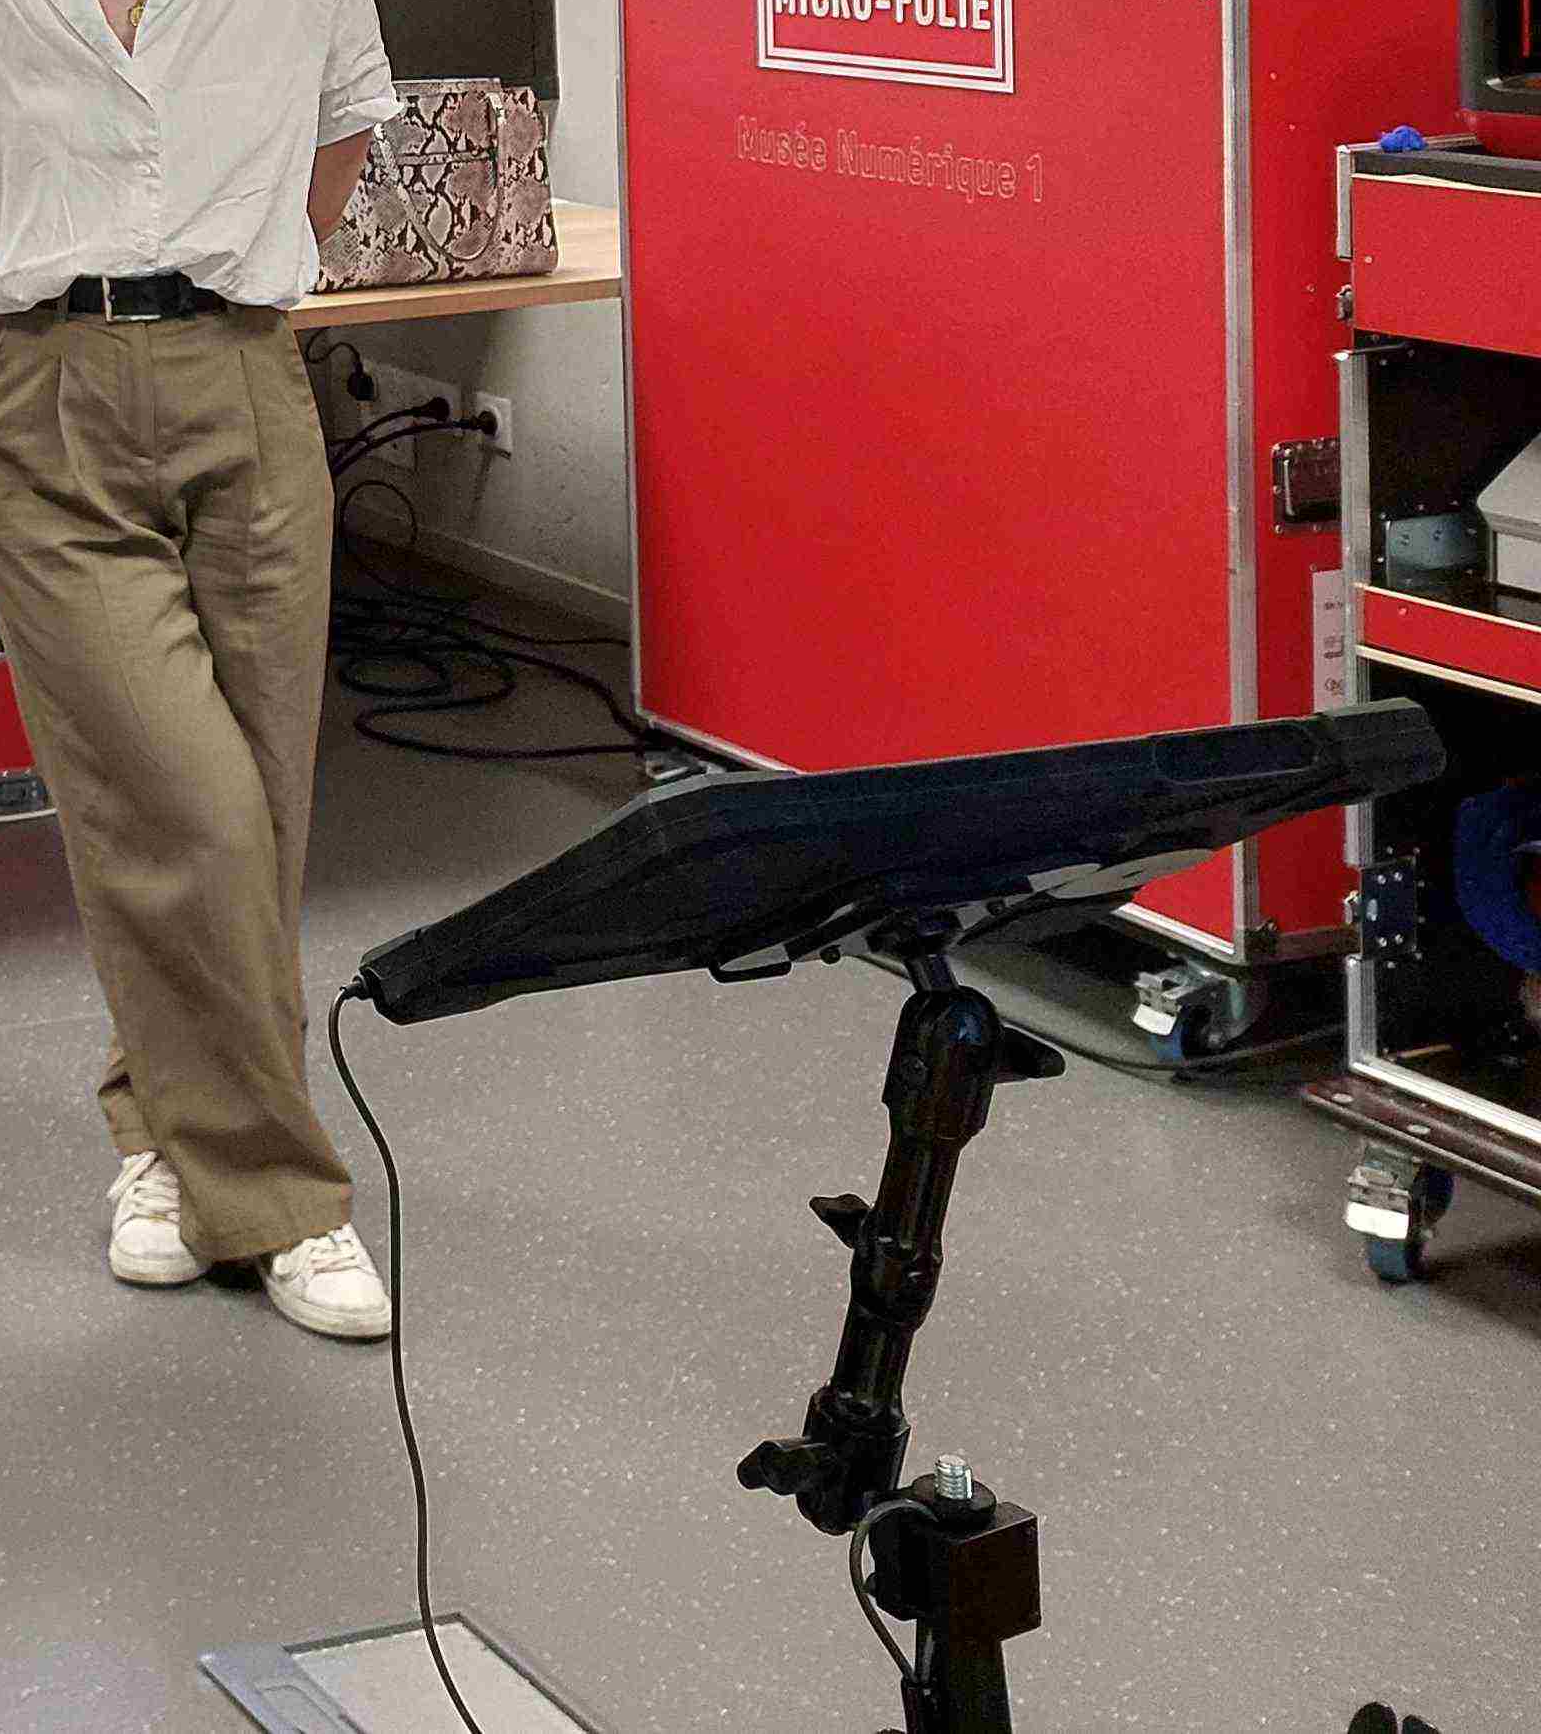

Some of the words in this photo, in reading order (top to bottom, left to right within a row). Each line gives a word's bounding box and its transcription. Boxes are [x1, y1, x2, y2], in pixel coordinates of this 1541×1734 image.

[736, 115, 828, 171] Musée
[835, 128, 1017, 204] Numérique
[1026, 152, 1045, 203] 1
